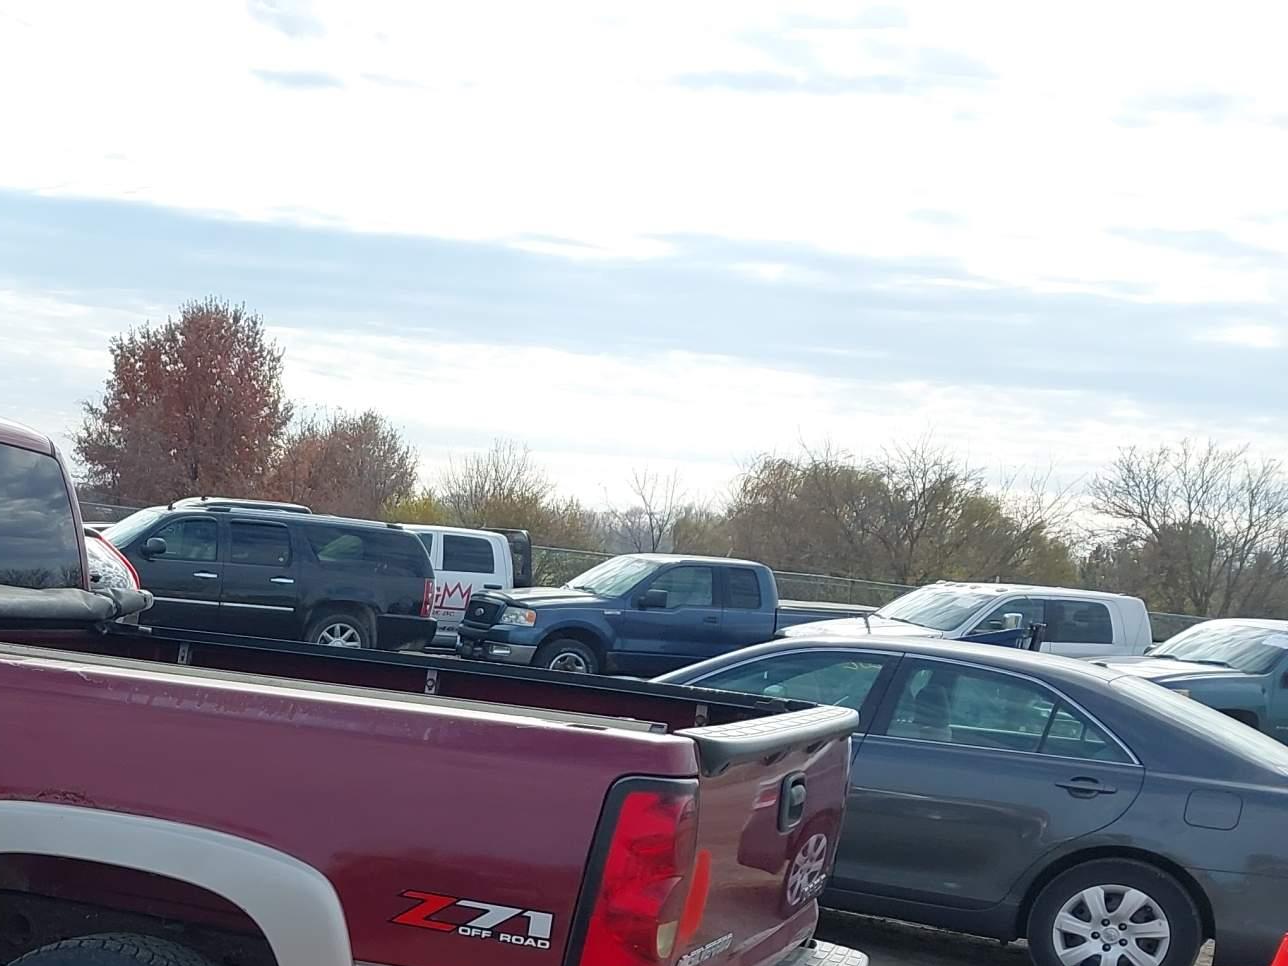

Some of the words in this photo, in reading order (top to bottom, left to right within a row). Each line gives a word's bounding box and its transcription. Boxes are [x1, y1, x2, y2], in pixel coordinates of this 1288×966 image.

[390, 889, 554, 935] Z71
[458, 926, 492, 939] OFF
[499, 933, 550, 949] ROAD
